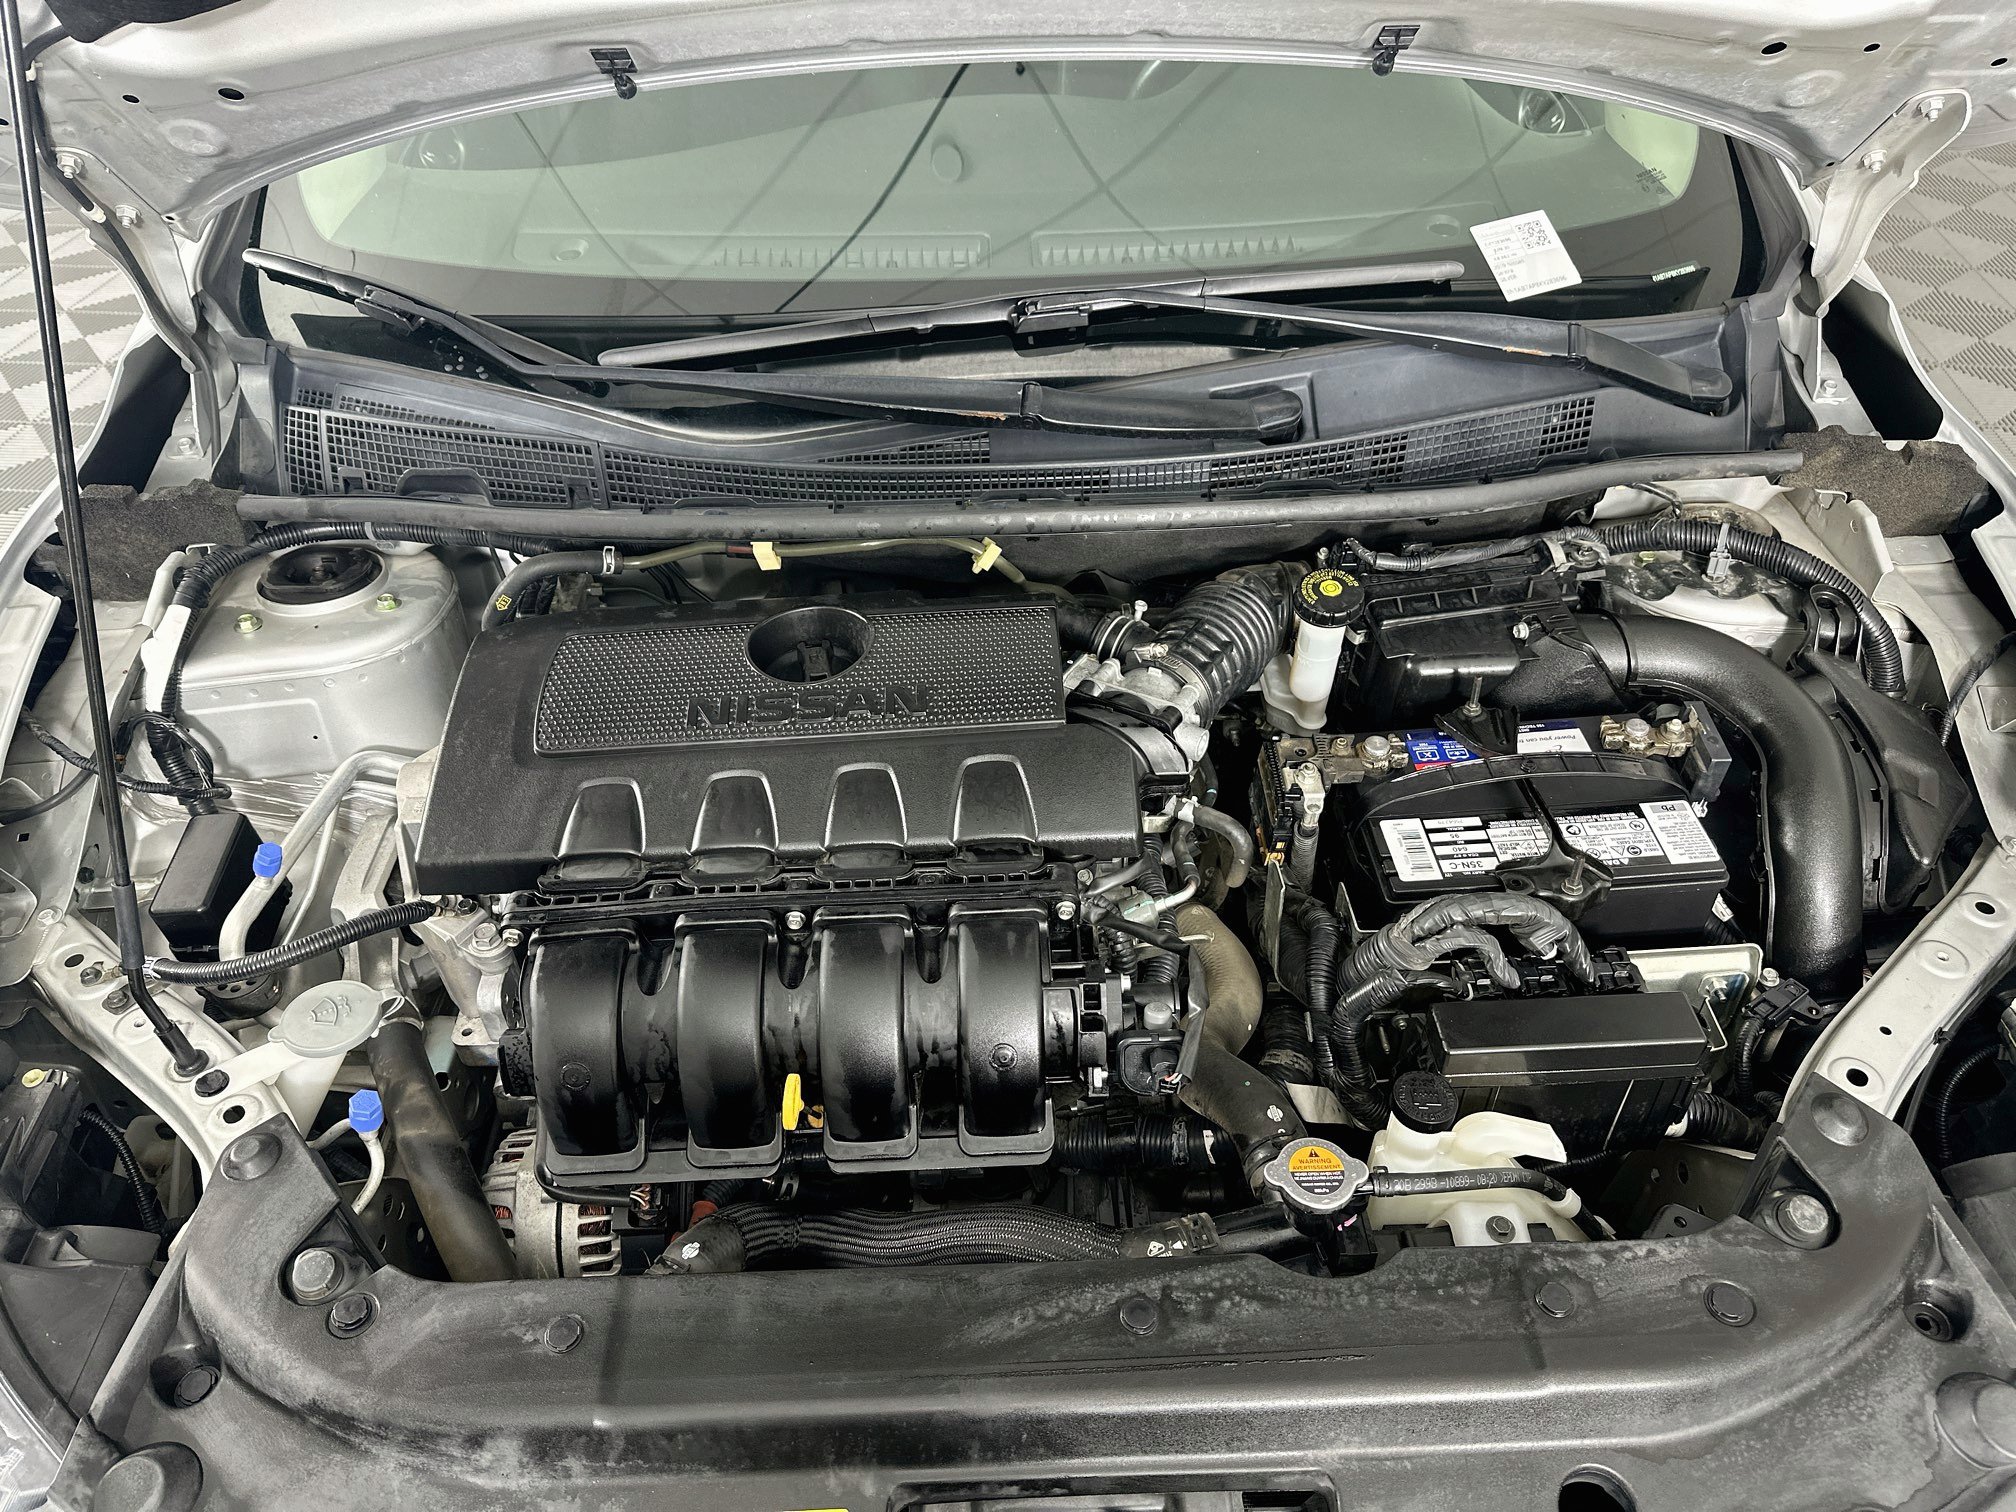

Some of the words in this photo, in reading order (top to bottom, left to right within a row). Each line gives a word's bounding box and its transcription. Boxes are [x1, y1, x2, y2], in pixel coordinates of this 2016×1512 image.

[684, 684, 928, 728] NISSAN
[1660, 804, 1676, 812] Pb
[1448, 860, 1484, 870] 35N-C
